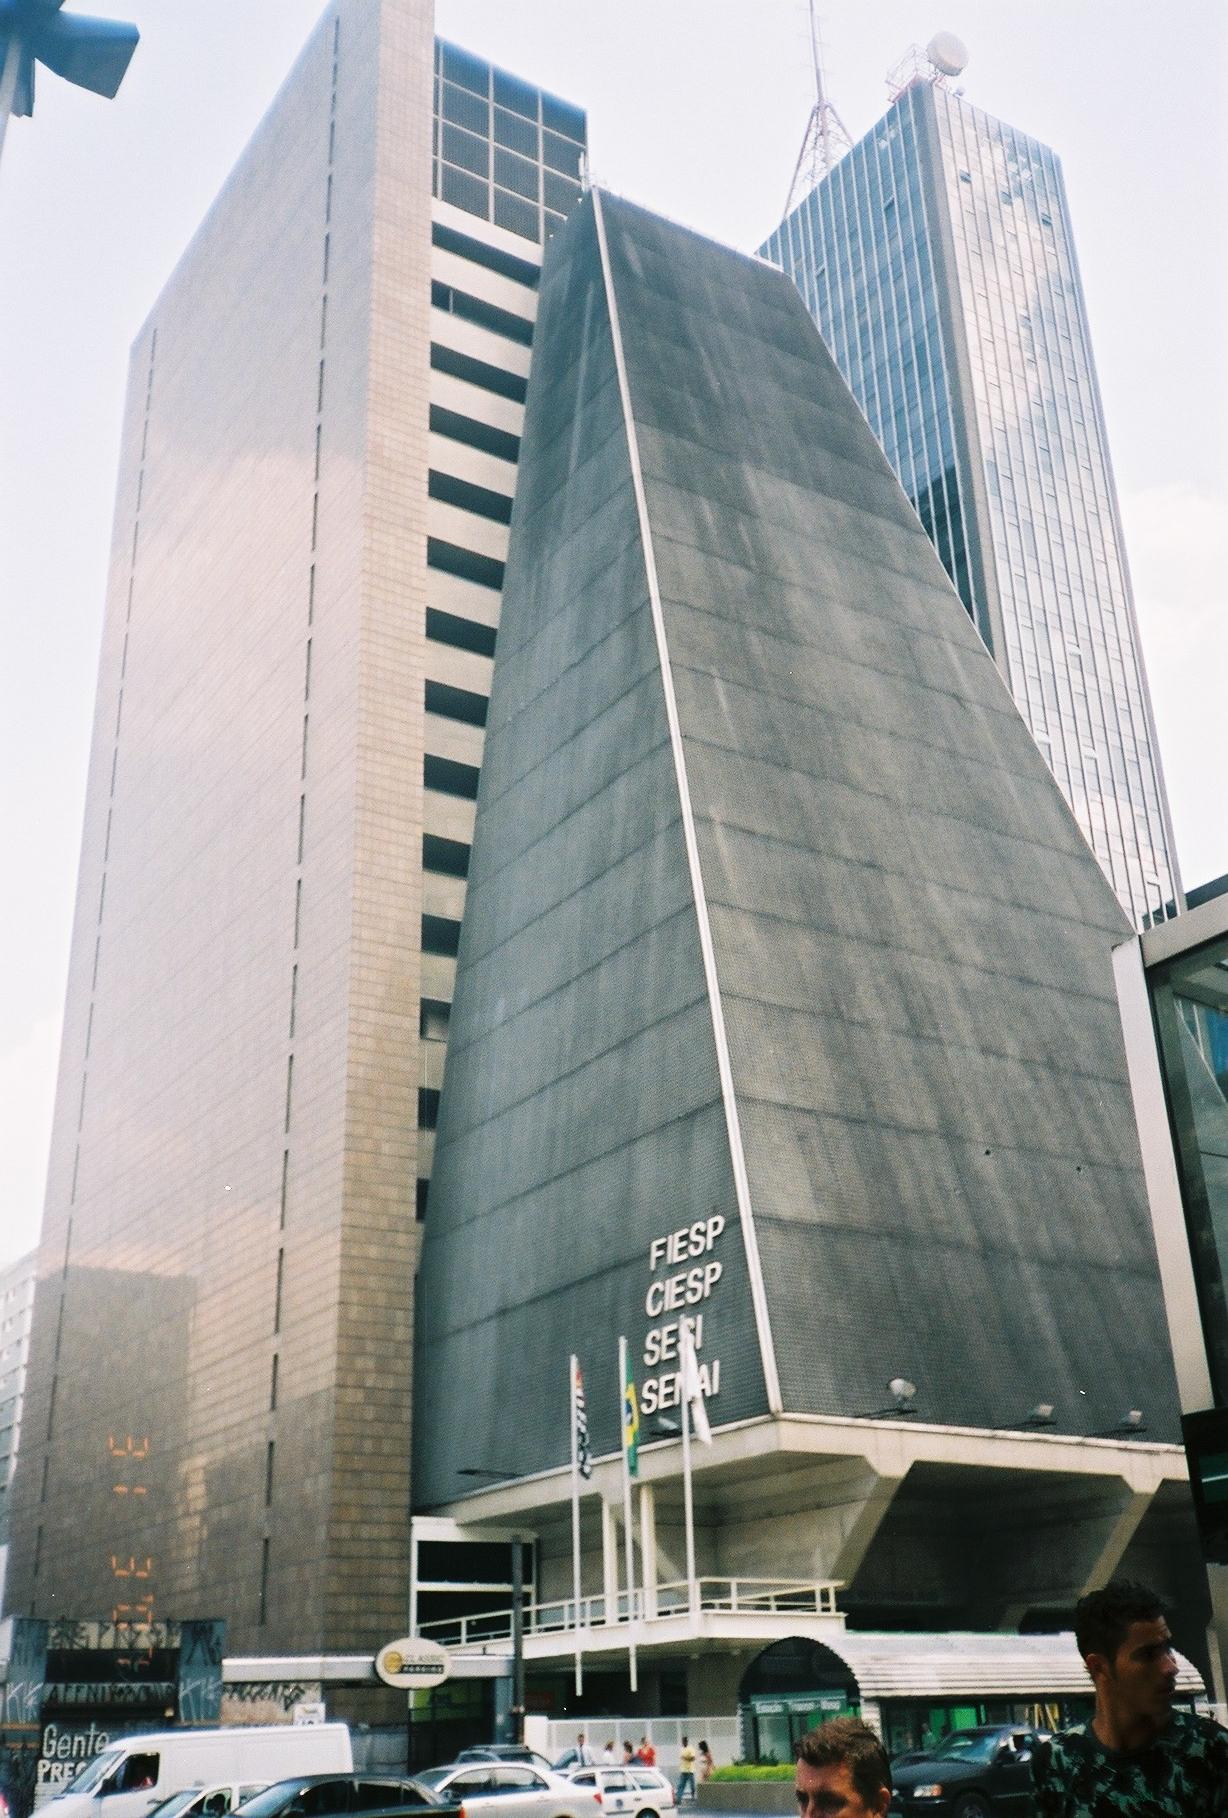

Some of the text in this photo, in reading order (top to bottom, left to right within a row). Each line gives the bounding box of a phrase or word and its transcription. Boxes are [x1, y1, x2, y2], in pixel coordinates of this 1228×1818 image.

[650, 1215, 725, 1271] FIESP
[645, 1261, 723, 1317] CIESP
[42, 1722, 109, 1759] Gente
